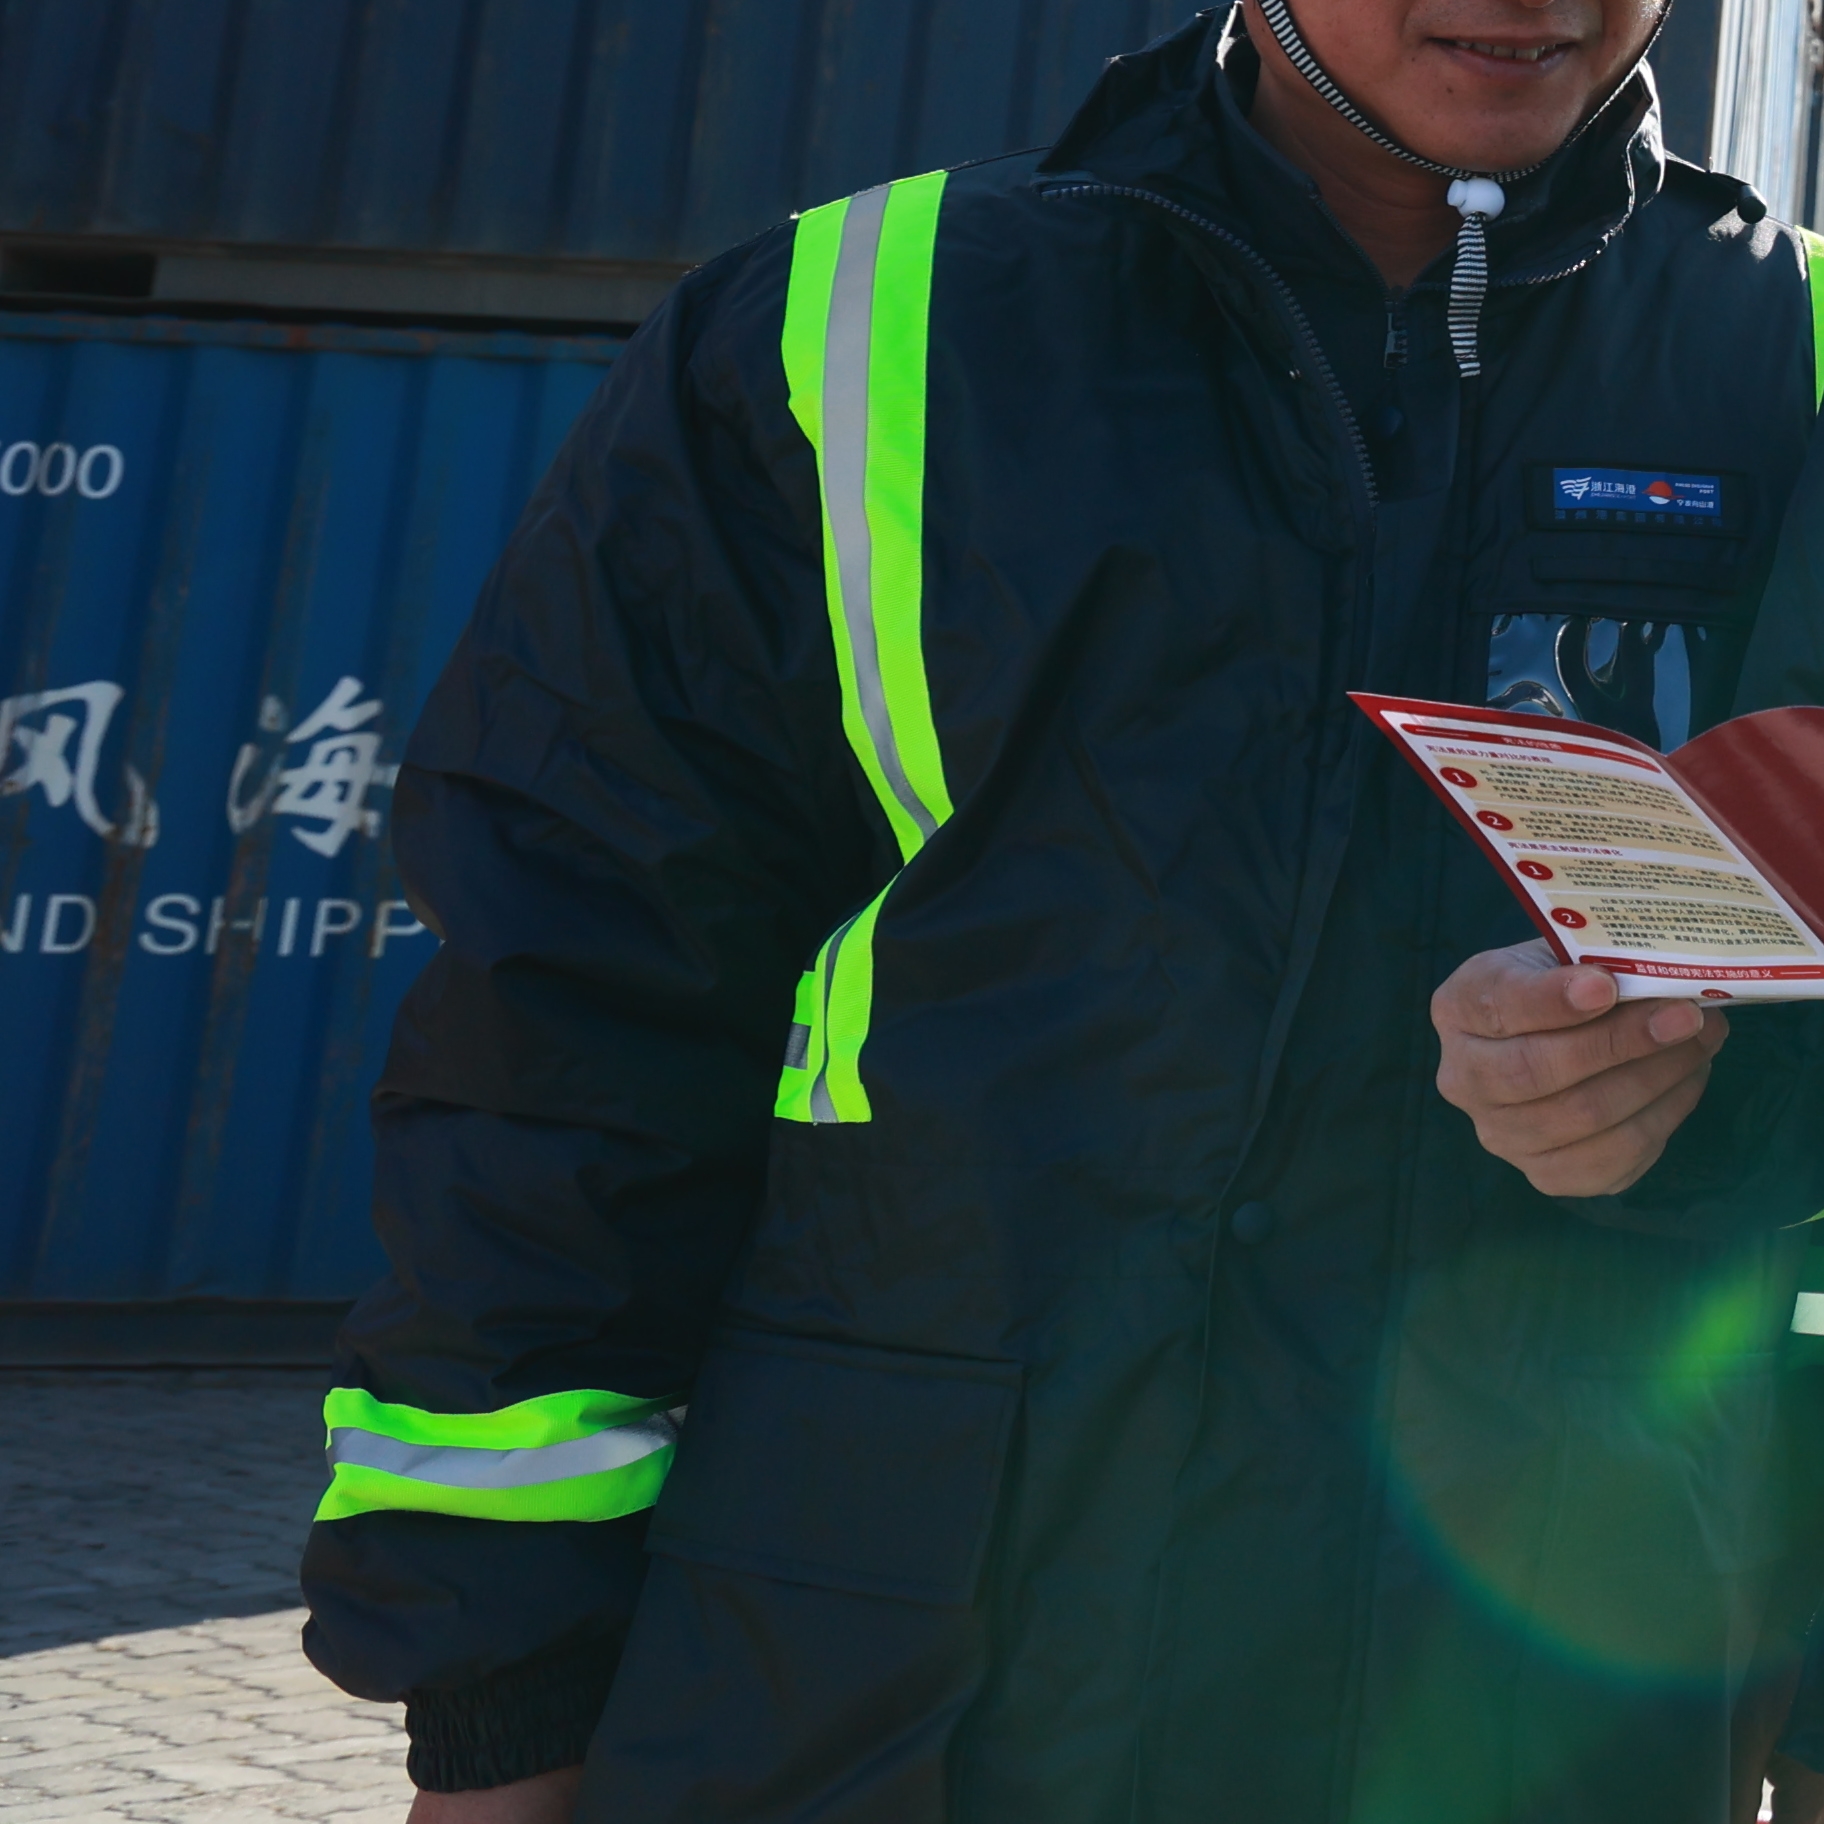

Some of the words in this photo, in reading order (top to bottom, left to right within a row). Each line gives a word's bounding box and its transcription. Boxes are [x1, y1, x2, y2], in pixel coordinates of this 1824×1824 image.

[1452, 772, 1466, 783] 1
[1488, 815, 1503, 826] 2
[1528, 865, 1543, 876] 1
[1562, 912, 1576, 924] 2
